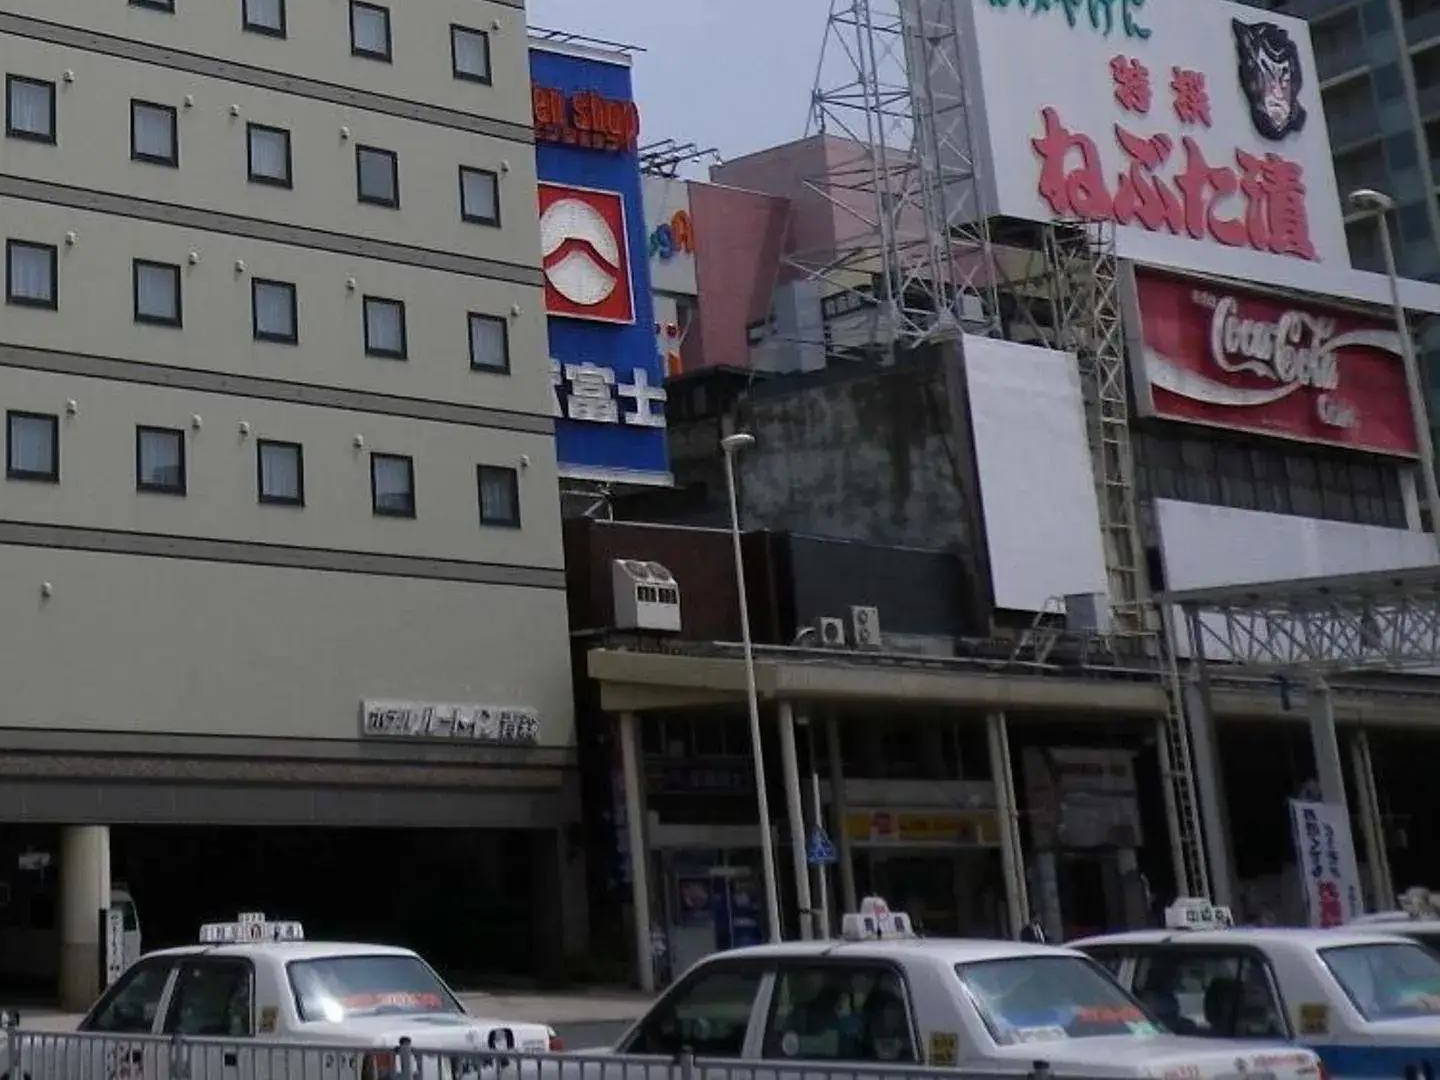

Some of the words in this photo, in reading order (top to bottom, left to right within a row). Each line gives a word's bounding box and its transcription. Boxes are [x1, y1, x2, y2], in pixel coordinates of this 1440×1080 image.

[1031, 105, 1321, 263] ねぶた漬
[550, 359, 668, 428] 富士
